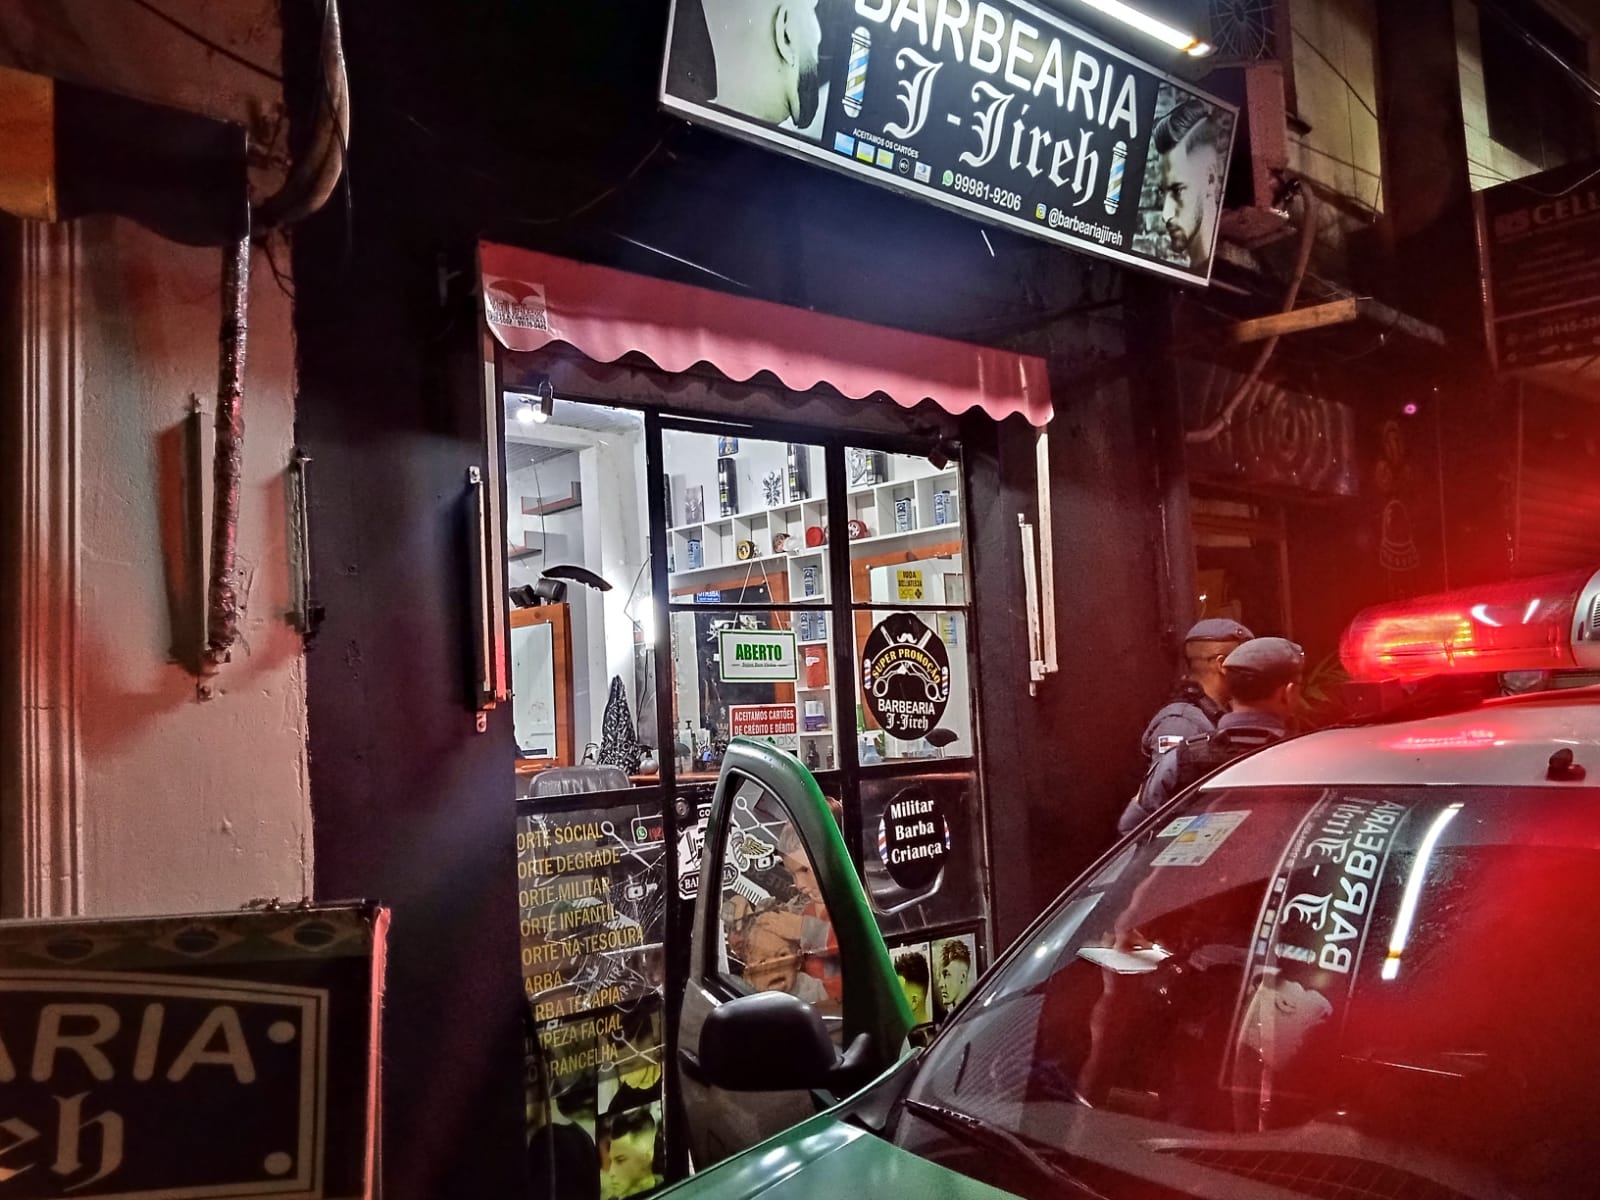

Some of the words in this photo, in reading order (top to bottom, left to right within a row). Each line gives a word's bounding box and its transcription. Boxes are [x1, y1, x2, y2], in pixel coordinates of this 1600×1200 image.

[853, 128, 886, 147] ACEITAMOS
[953, 173, 1023, 212] 99981-9206
[1047, 207, 1124, 248] @barbeariajjireh
[735, 643, 783, 662] ABERTO
[871, 650, 898, 679] SUPER
[897, 648, 942, 684] PROMOÇÃO
[734, 710, 769, 722] ACEITAMOS
[768, 707, 794, 720] CARTÕES
[877, 698, 936, 715] BARBEARIA
[734, 724, 743, 735] DE
[743, 721, 769, 735] CRÉDITO
[769, 723, 775, 734] E
[774, 720, 795, 734] DÉBITO
[890, 799, 935, 820] Militar
[516, 828, 552, 852] ORTE
[895, 820, 935, 841] Barba
[517, 857, 554, 881] ORTE
[556, 847, 622, 874] DEGRADE
[891, 842, 943, 865] Criança
[518, 885, 555, 909] ORTE
[559, 876, 612, 901] MILITAR
[520, 914, 558, 938] ORTE
[559, 903, 619, 930] INFANTIL
[521, 942, 560, 967] ORTE
[561, 937, 582, 959] NA
[582, 926, 645, 954] TESOURA
[524, 970, 563, 995] ARBA
[534, 999, 566, 1024] RBA
[566, 985, 623, 1014] TERAPIA
[540, 1025, 578, 1050] PEZA
[580, 1012, 624, 1041] FACIAL
[549, 1041, 619, 1078] RANCELHA
